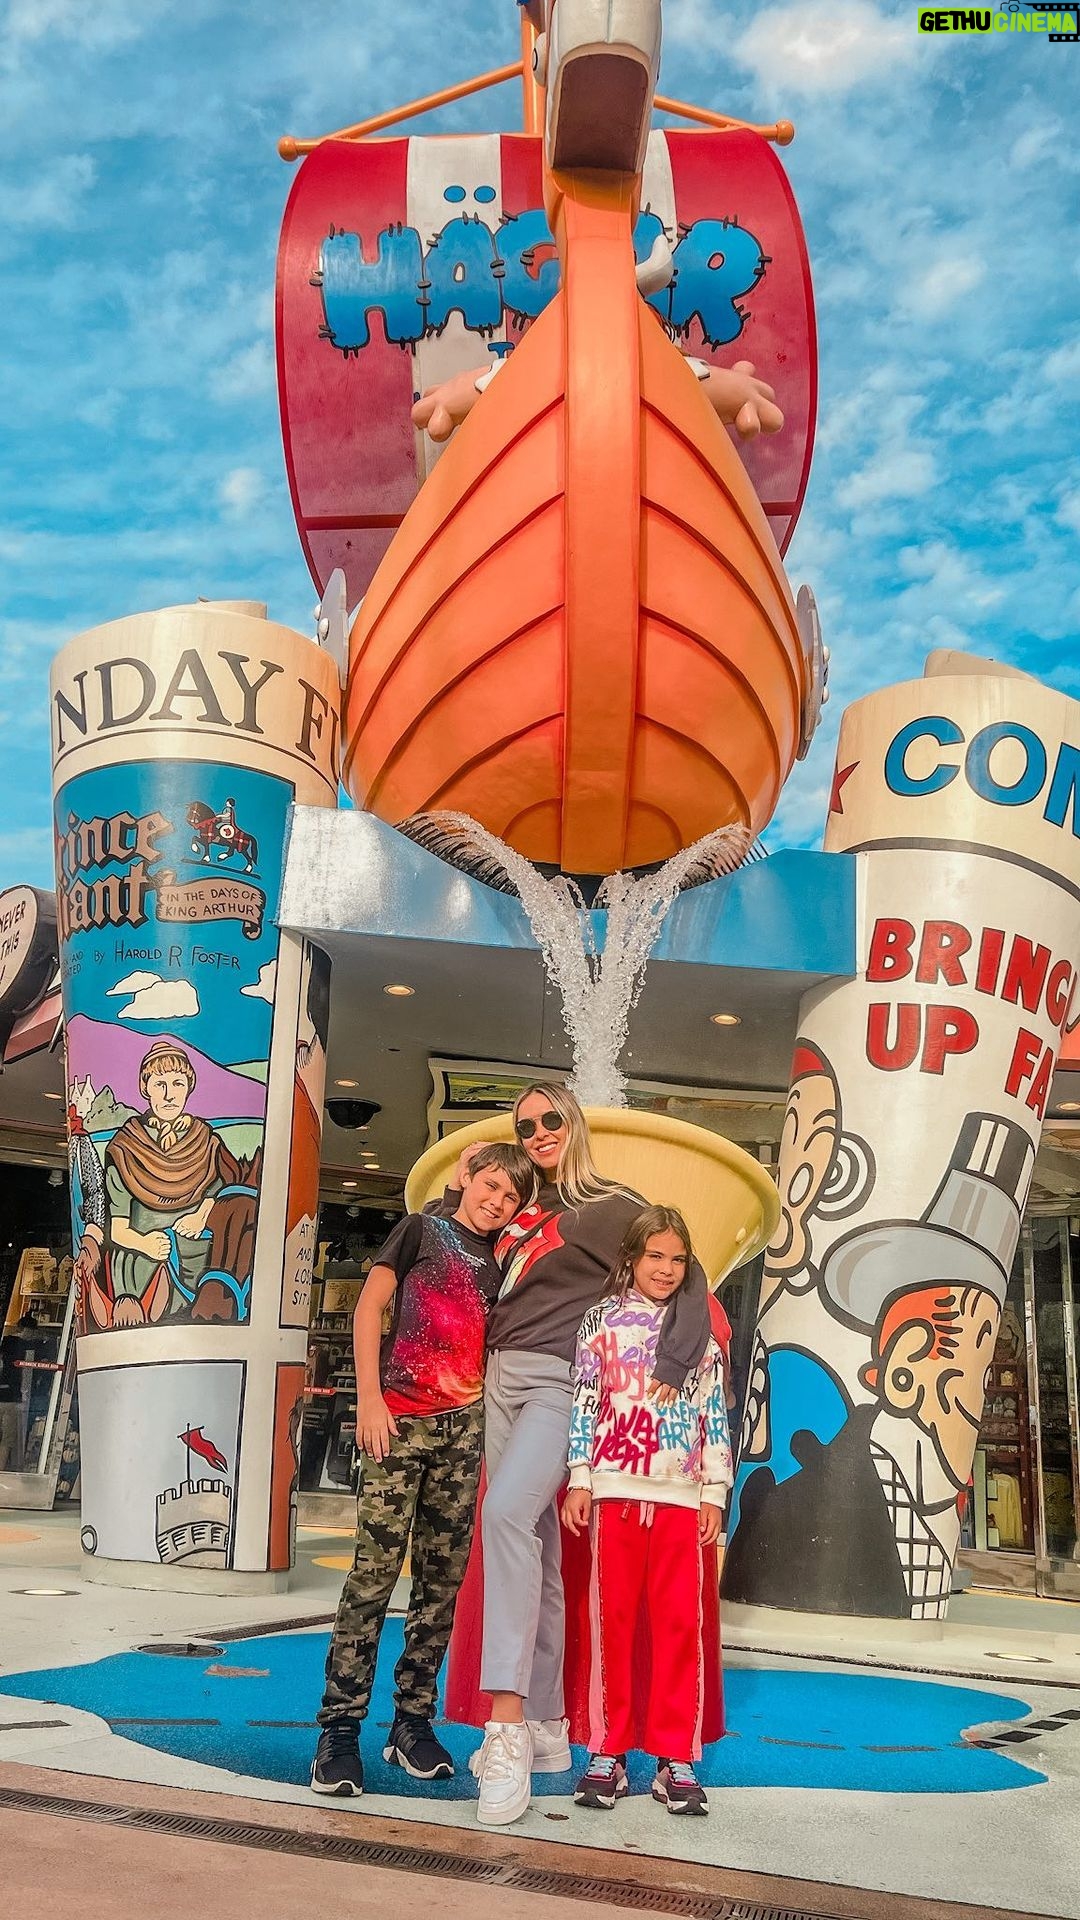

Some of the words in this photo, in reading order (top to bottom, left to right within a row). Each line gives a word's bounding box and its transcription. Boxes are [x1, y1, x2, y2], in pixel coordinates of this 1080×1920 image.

[167, 893, 179, 902] IN
[185, 890, 205, 901] THE
[211, 887, 239, 899] DAYS
[241, 890, 258, 901] OF
[165, 905, 197, 918] KING
[203, 903, 255, 917] ARTHUR
[168, 945, 183, 967] R
[865, 1002, 979, 1076] UP
